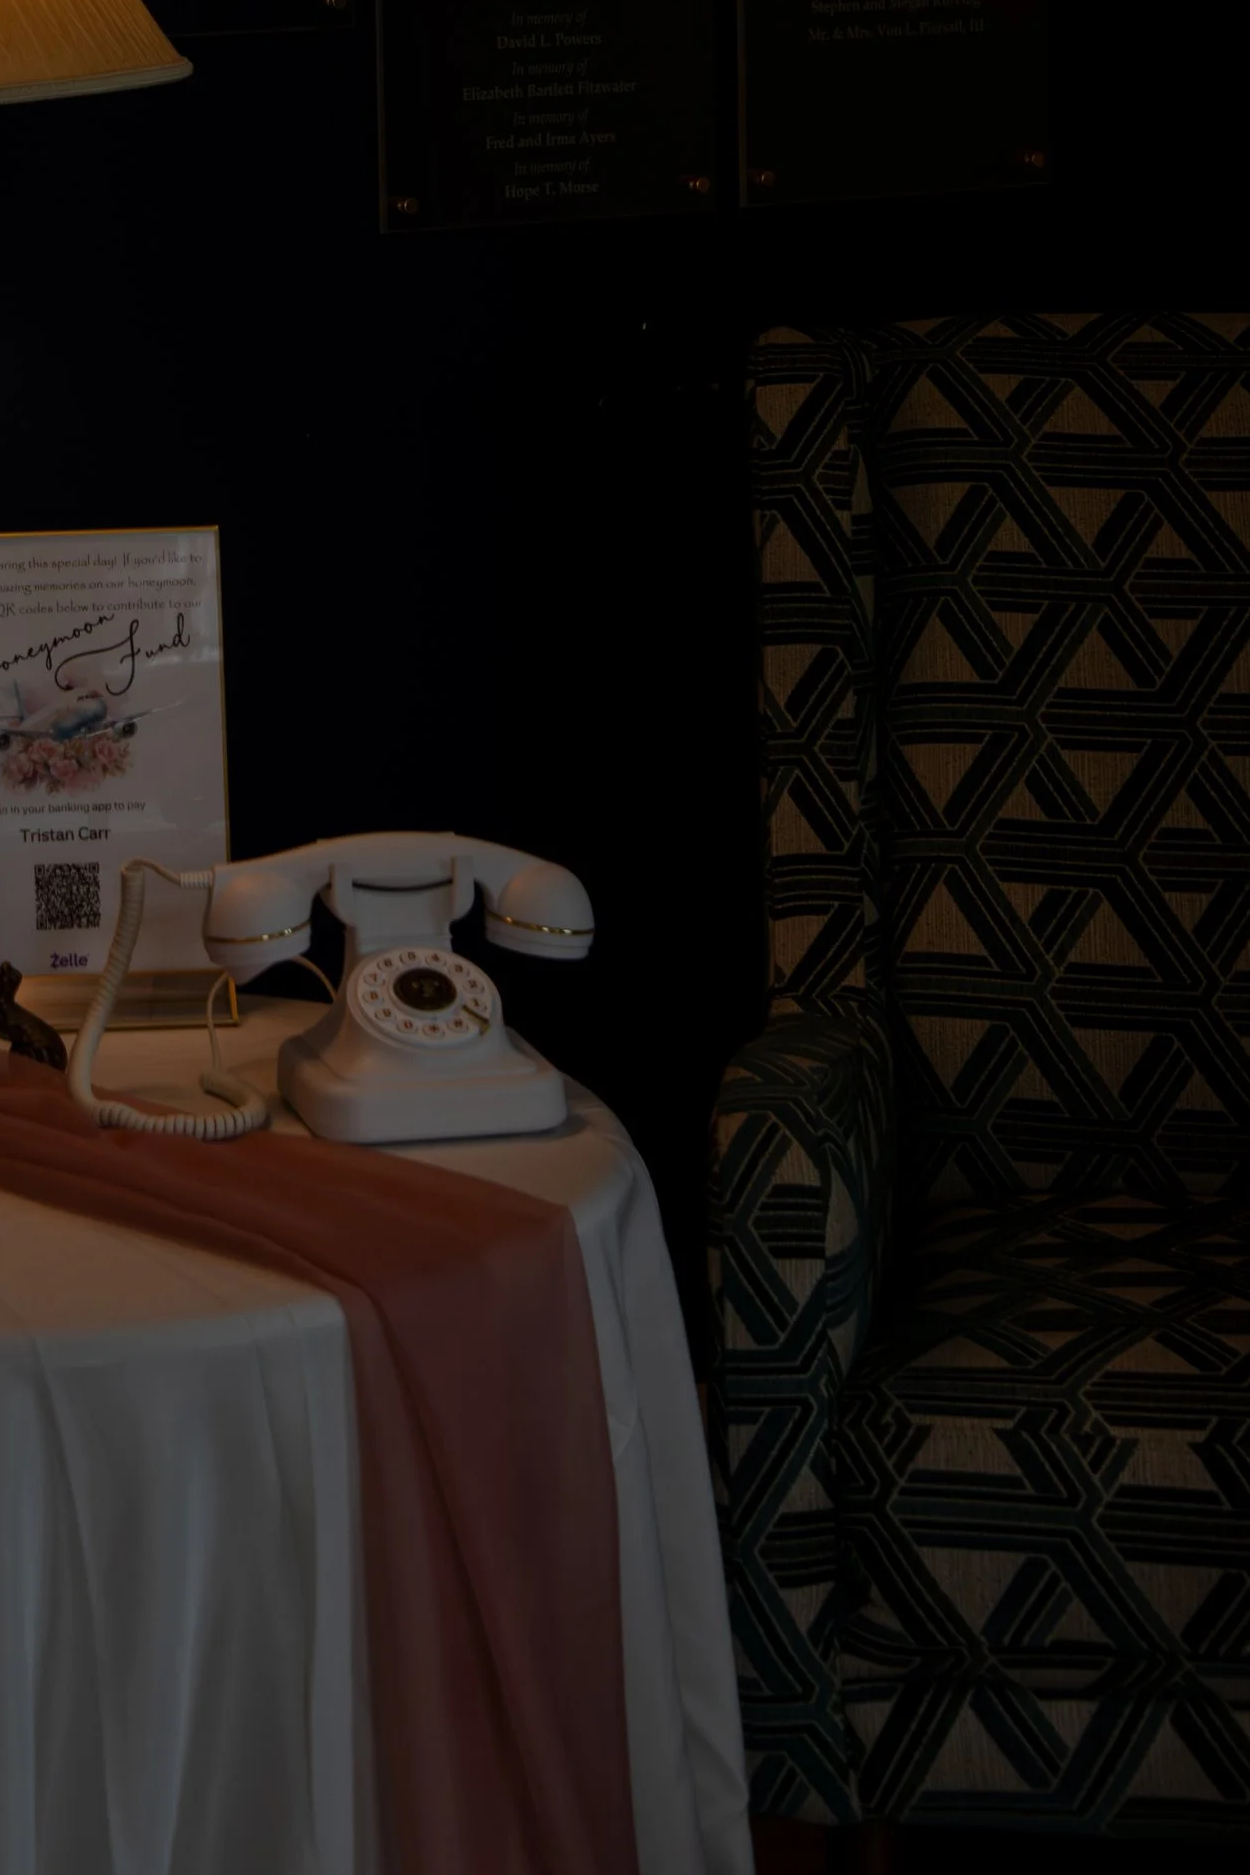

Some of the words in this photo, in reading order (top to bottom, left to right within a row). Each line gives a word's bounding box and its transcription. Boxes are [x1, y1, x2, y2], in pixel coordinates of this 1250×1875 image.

[34, 580, 87, 592] memories
[88, 581, 104, 590] on
[106, 579, 126, 589] our
[54, 613, 191, 696] Fund
[10, 805, 20, 814] in
[22, 805, 45, 816] your
[48, 802, 90, 814] banking
[92, 803, 112, 812] app
[114, 801, 125, 810] to
[127, 800, 146, 812] pay
[20, 828, 75, 843] Tristan
[78, 827, 111, 841] Carr
[50, 952, 88, 969] Zelle
